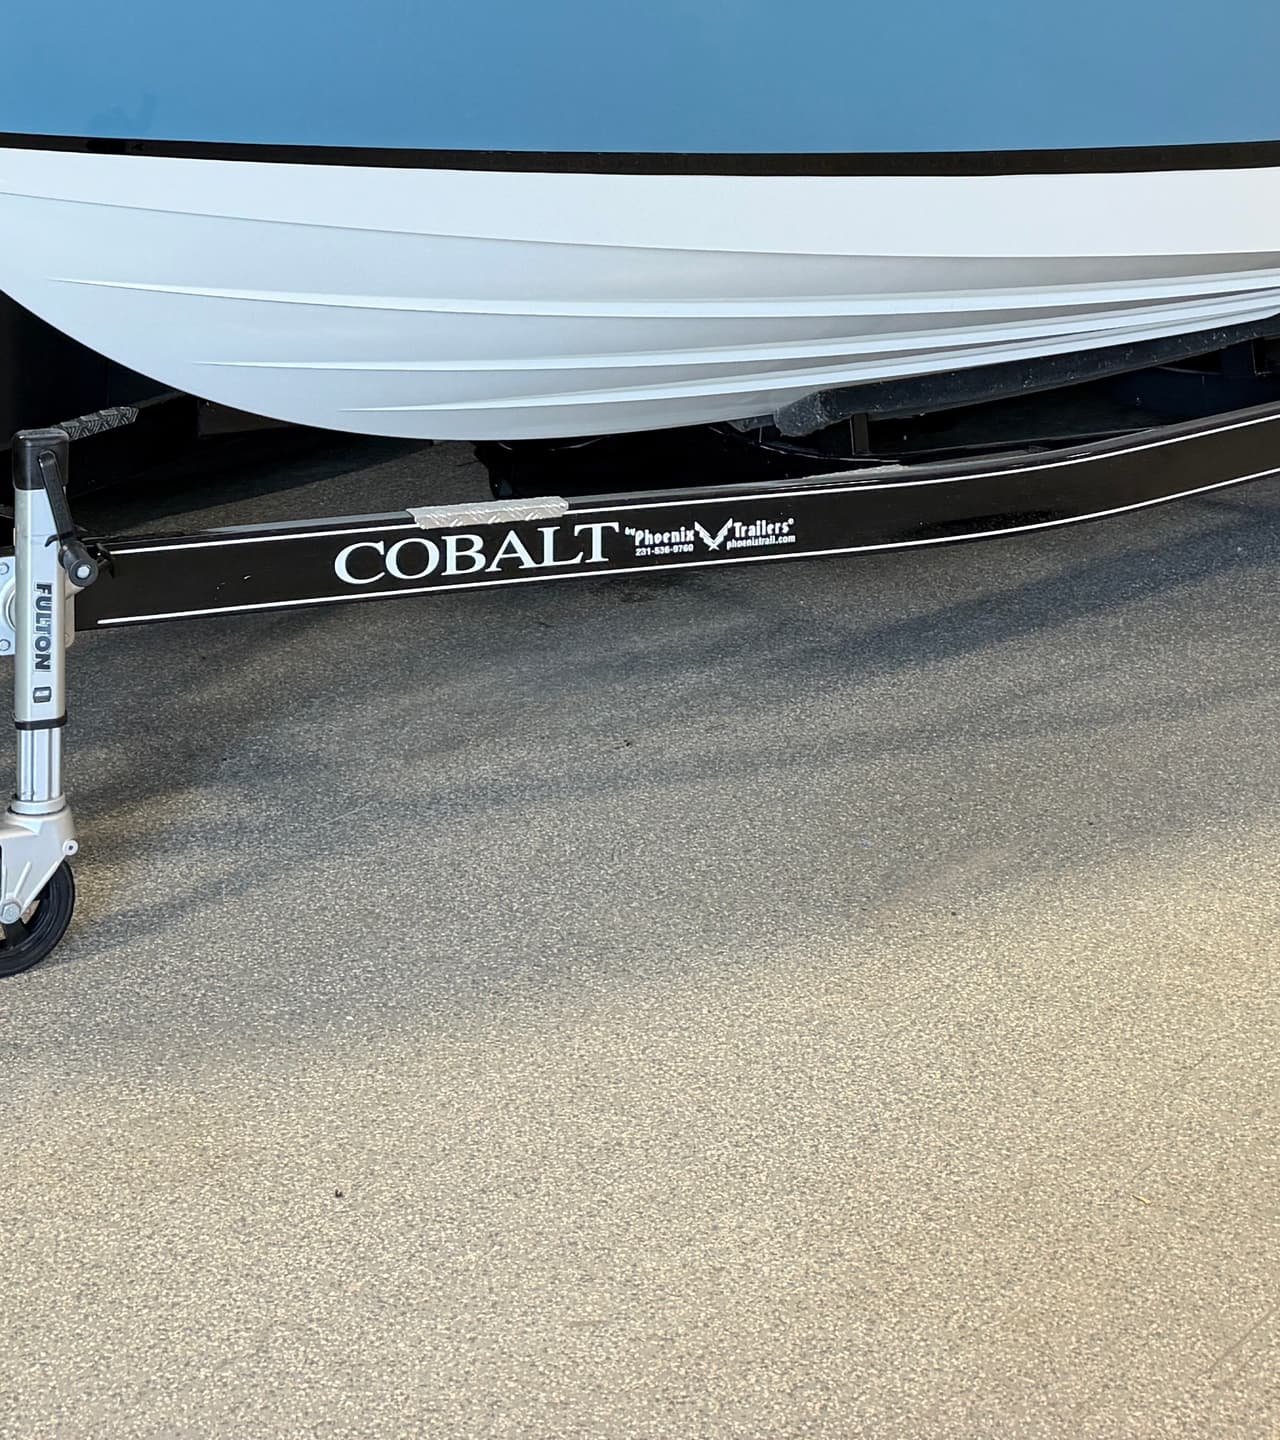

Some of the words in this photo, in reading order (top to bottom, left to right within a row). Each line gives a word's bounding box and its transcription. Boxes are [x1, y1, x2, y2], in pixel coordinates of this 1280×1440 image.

[334, 521, 619, 585] COBALT
[635, 526, 695, 546] Phoenix
[34, 582, 53, 671] FULTON
